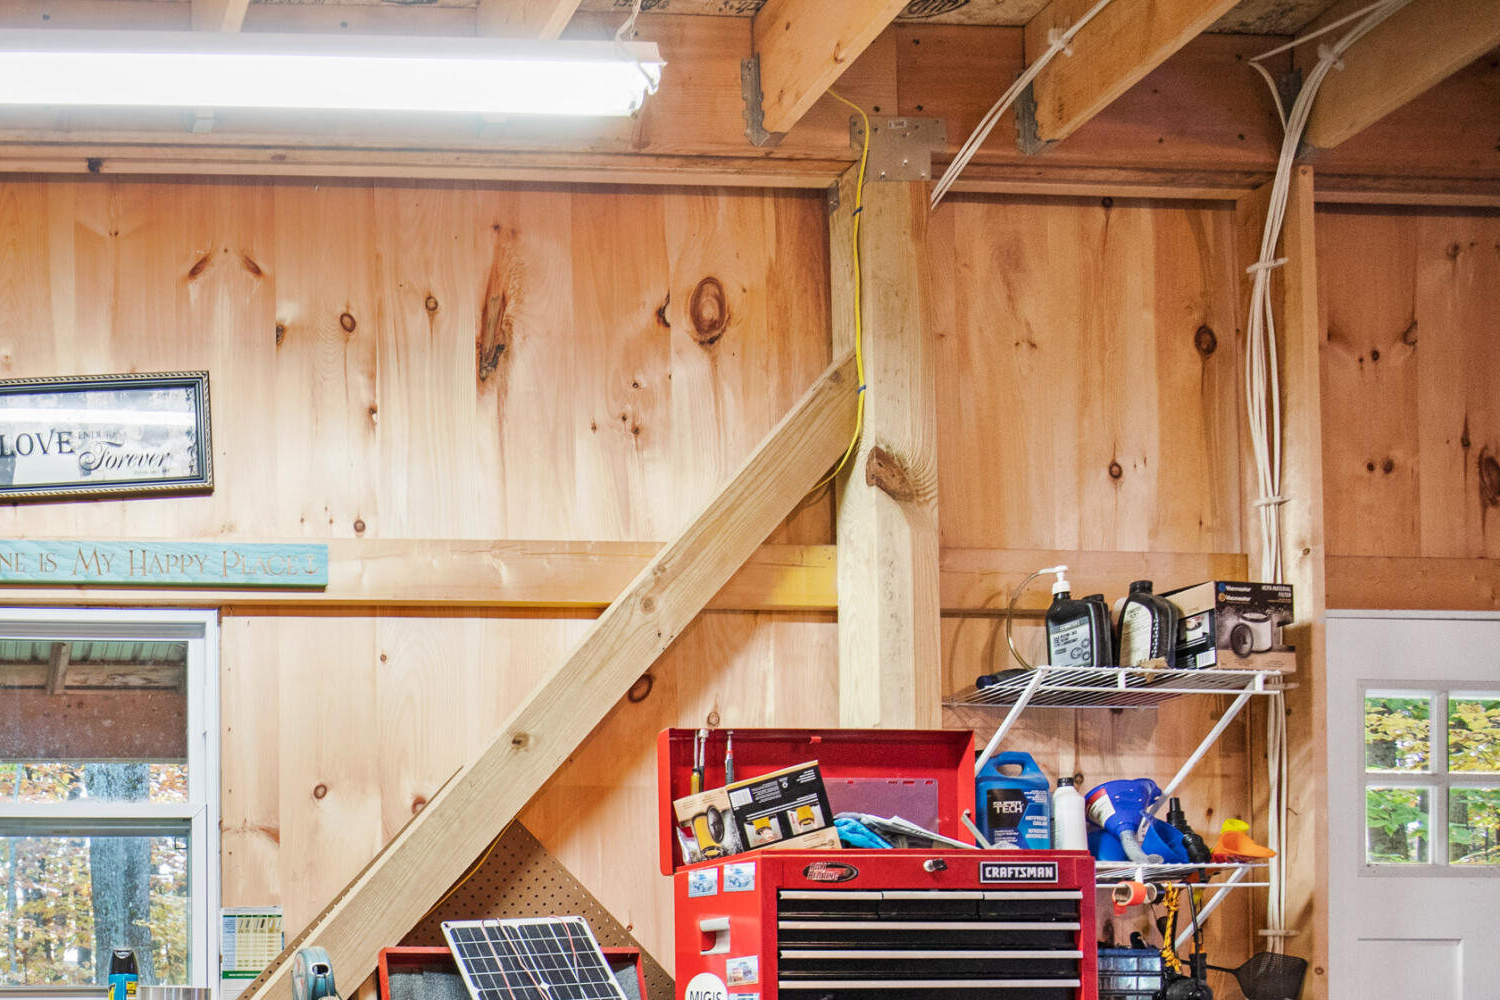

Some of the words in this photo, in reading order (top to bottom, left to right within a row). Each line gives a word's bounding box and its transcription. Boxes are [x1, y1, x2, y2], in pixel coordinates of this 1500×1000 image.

[78, 440, 172, 472] Forever
[73, 547, 118, 575] MY
[129, 549, 211, 577] HAPPY
[221, 550, 299, 577] PLACE
[994, 805, 1024, 814] TECH
[984, 866, 1054, 879] CRAFTSMAN
